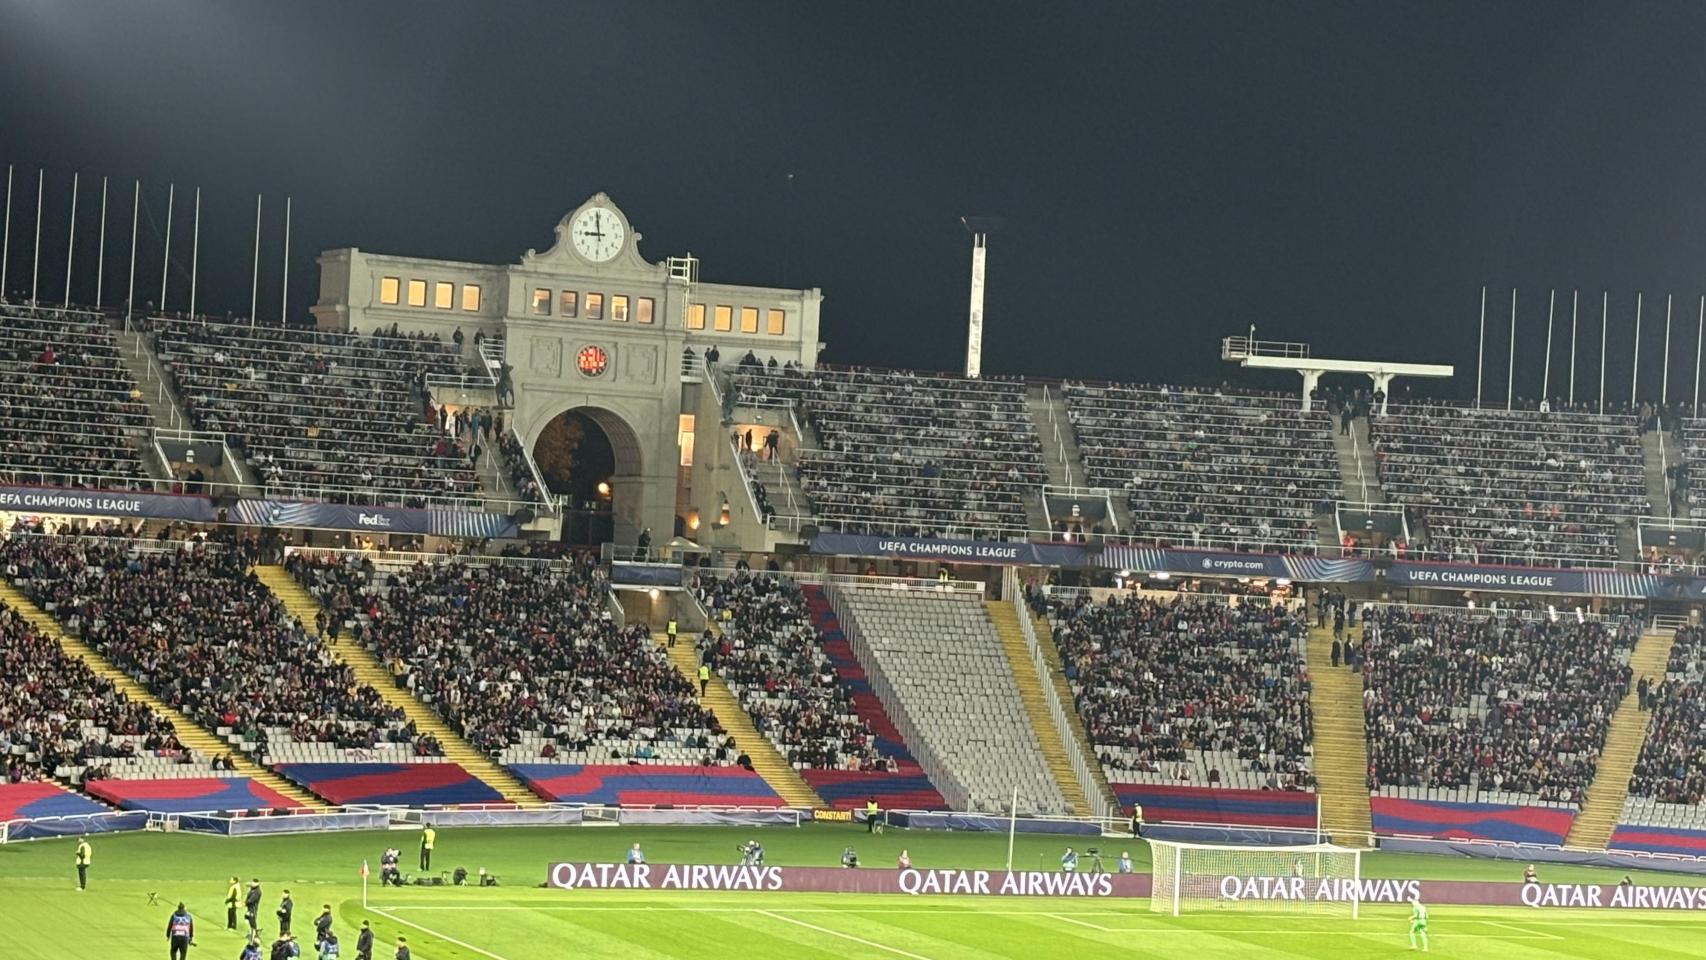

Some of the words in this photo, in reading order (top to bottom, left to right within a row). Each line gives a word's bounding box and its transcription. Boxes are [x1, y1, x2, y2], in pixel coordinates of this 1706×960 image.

[0, 493, 21, 505] EFA
[24, 494, 92, 509] CHAMPIONS
[96, 499, 140, 511] LEAGUE
[359, 513, 391, 526] FedEx
[879, 541, 907, 552] UEFA
[909, 543, 973, 556] CHAMPIONS
[976, 547, 1017, 558] LEAGUE
[1214, 560, 1264, 570] crypto.com
[1409, 570, 1438, 581] UEFA
[1441, 572, 1507, 585] CHAMPIONS
[1510, 575, 1553, 587] LEAGUE
[552, 863, 651, 890] QATAR
[661, 865, 783, 890] AIRWAYS
[899, 869, 990, 896] QATAR
[1000, 872, 1113, 896] AIRWAYS
[1220, 875, 1306, 901] QATAR
[1315, 878, 1420, 902] AIRWAYS
[1521, 883, 1602, 908] QATAR
[1610, 886, 1706, 909] AIRWAYS
